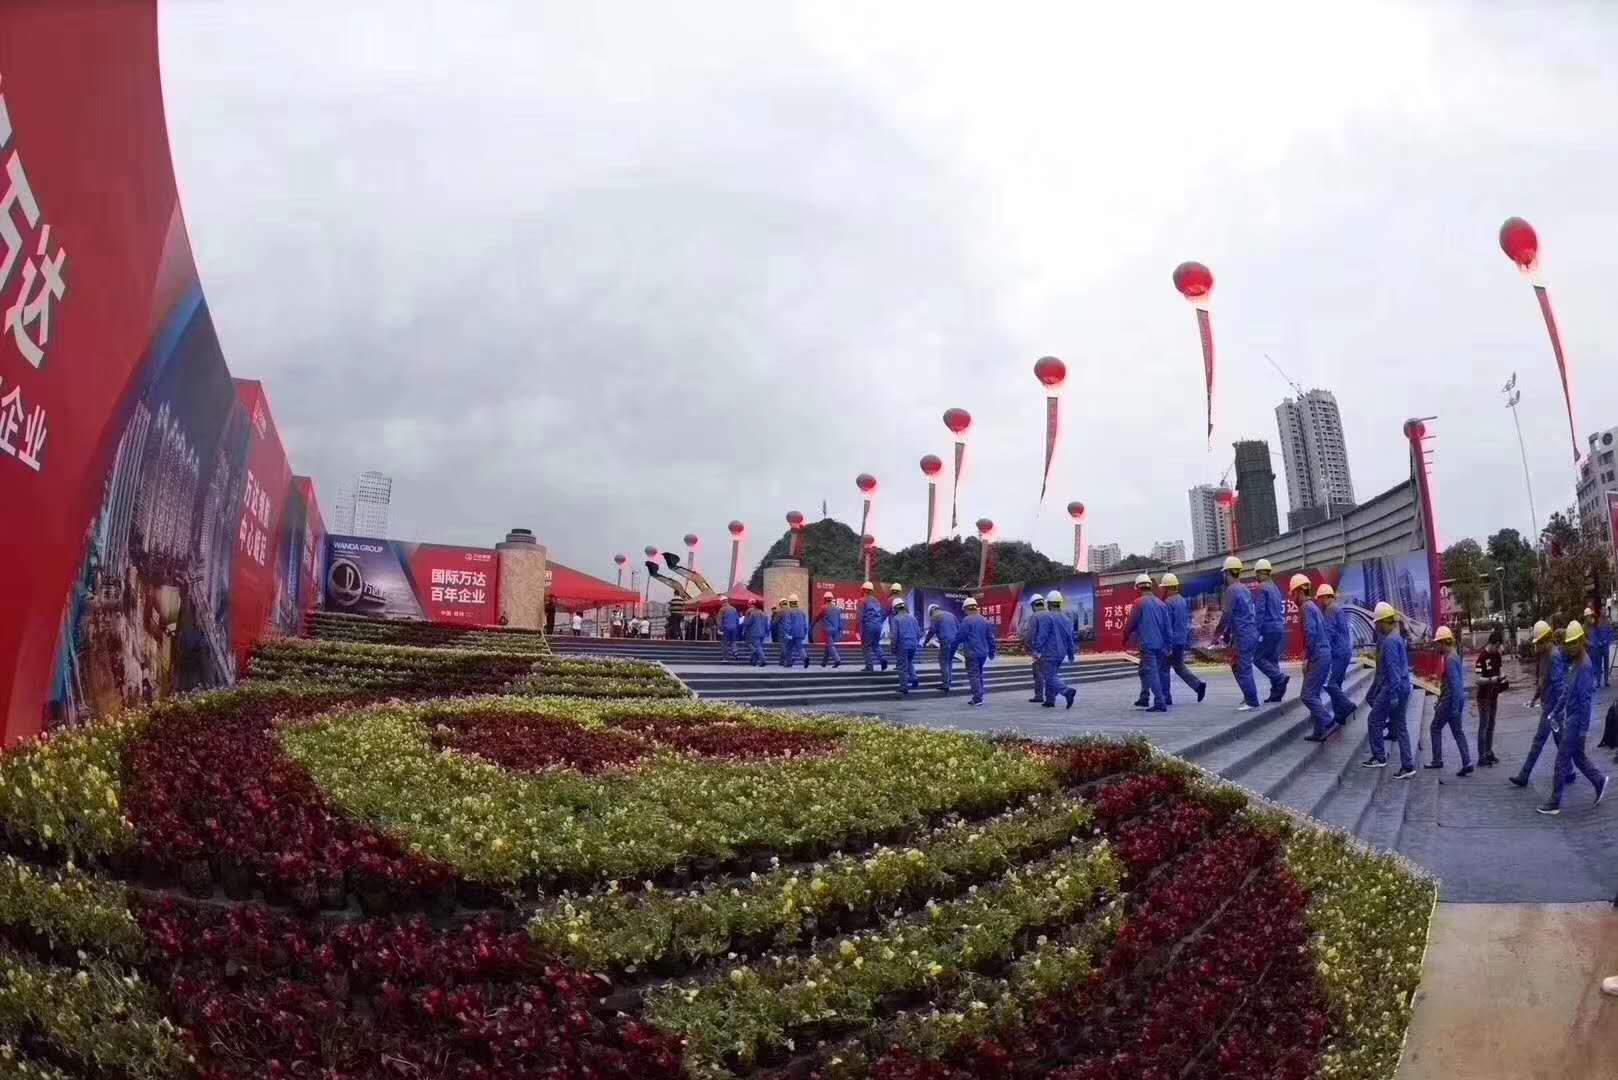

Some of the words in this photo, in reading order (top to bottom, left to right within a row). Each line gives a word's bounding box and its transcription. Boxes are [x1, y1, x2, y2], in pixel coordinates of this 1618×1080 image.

[0, 73, 66, 368] 万达
[334, 542, 359, 551] WANDA
[360, 544, 383, 552] GROUP
[432, 568, 486, 587] 国际万达
[431, 587, 486, 604] 百年企业
